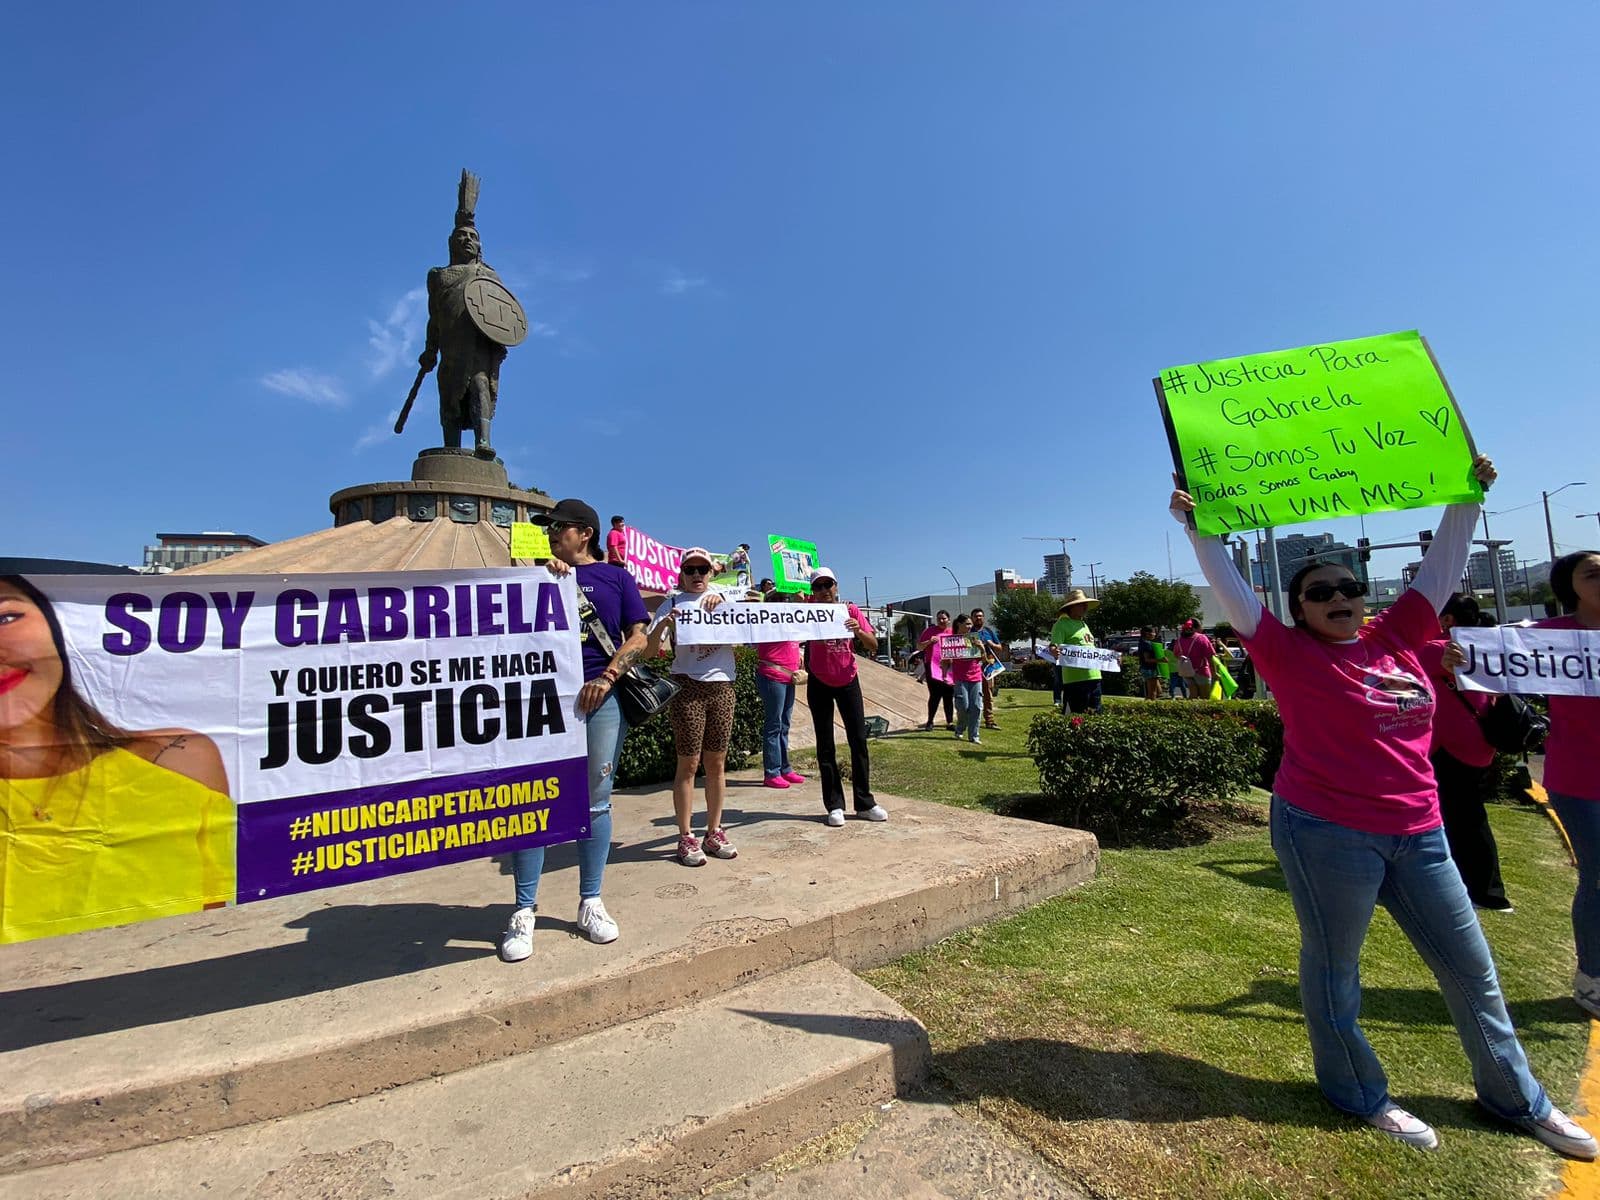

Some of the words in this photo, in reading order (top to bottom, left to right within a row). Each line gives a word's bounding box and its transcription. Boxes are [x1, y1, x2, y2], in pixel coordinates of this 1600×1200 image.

[1309, 346, 1389, 372] Para
[1221, 385, 1362, 428] Gabriela
[1322, 427, 1356, 455] Tu
[1364, 421, 1417, 450] Voz
[1193, 482, 1248, 504] Todas
[1308, 466, 1359, 483] Gaby
[1288, 491, 1351, 517] UNA
[627, 559, 667, 591] PARA
[102, 590, 256, 657] SOY
[274, 581, 570, 648] GABRIELA
[678, 608, 836, 626] #JusticiaParaGABY
[270, 669, 290, 697] Y
[297, 661, 403, 697] QUIERO
[410, 659, 442, 686] SE
[448, 655, 485, 682] ME
[491, 650, 558, 679] HAGA
[1463, 644, 1600, 680] Justici
[260, 678, 567, 770] JUSTICIA
[289, 776, 560, 841] #NIUNCARPETAZOMAS
[292, 808, 550, 876] #JUSTICIAPARAGABY
